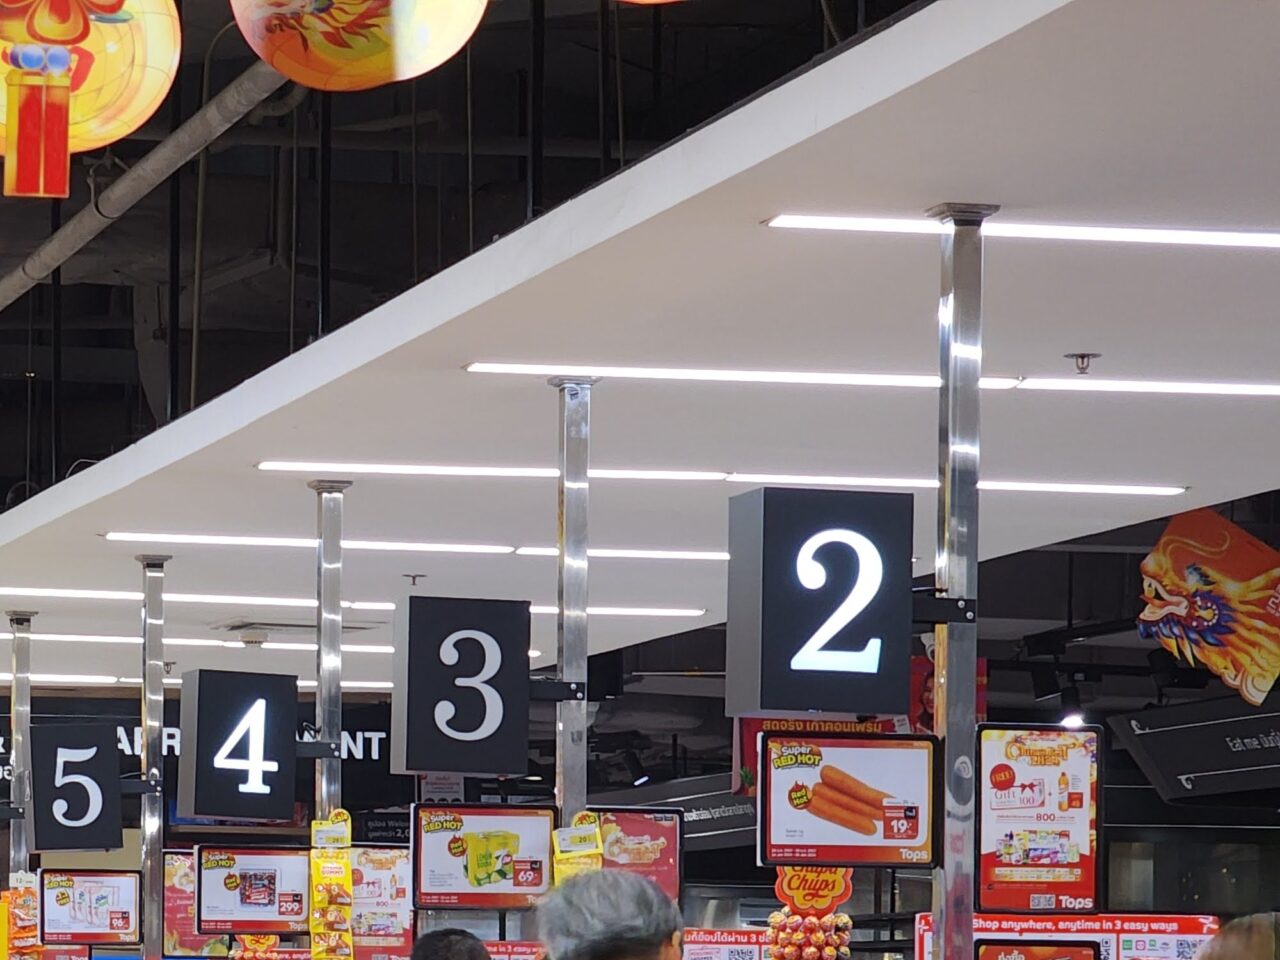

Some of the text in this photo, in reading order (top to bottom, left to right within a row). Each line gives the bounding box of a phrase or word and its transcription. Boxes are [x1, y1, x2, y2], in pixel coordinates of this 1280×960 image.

[788, 527, 884, 675] 2
[433, 628, 504, 742] 3
[213, 697, 279, 796] 4
[781, 745, 812, 755] Super
[773, 754, 822, 769] RED HOT
[51, 745, 104, 828] 5
[1035, 812, 1056, 822] 800
[423, 820, 463, 832] RED HOT
[890, 819, 908, 834] 19
[899, 848, 929, 862] Tops
[518, 870, 534, 883] 69
[787, 872, 837, 894] Chups
[279, 901, 300, 913] 299
[1058, 895, 1093, 910] Tops
[972, 918, 1179, 932] Shop anywhere, anytime in 3 easy ways
[750, 934, 757, 942] 3
